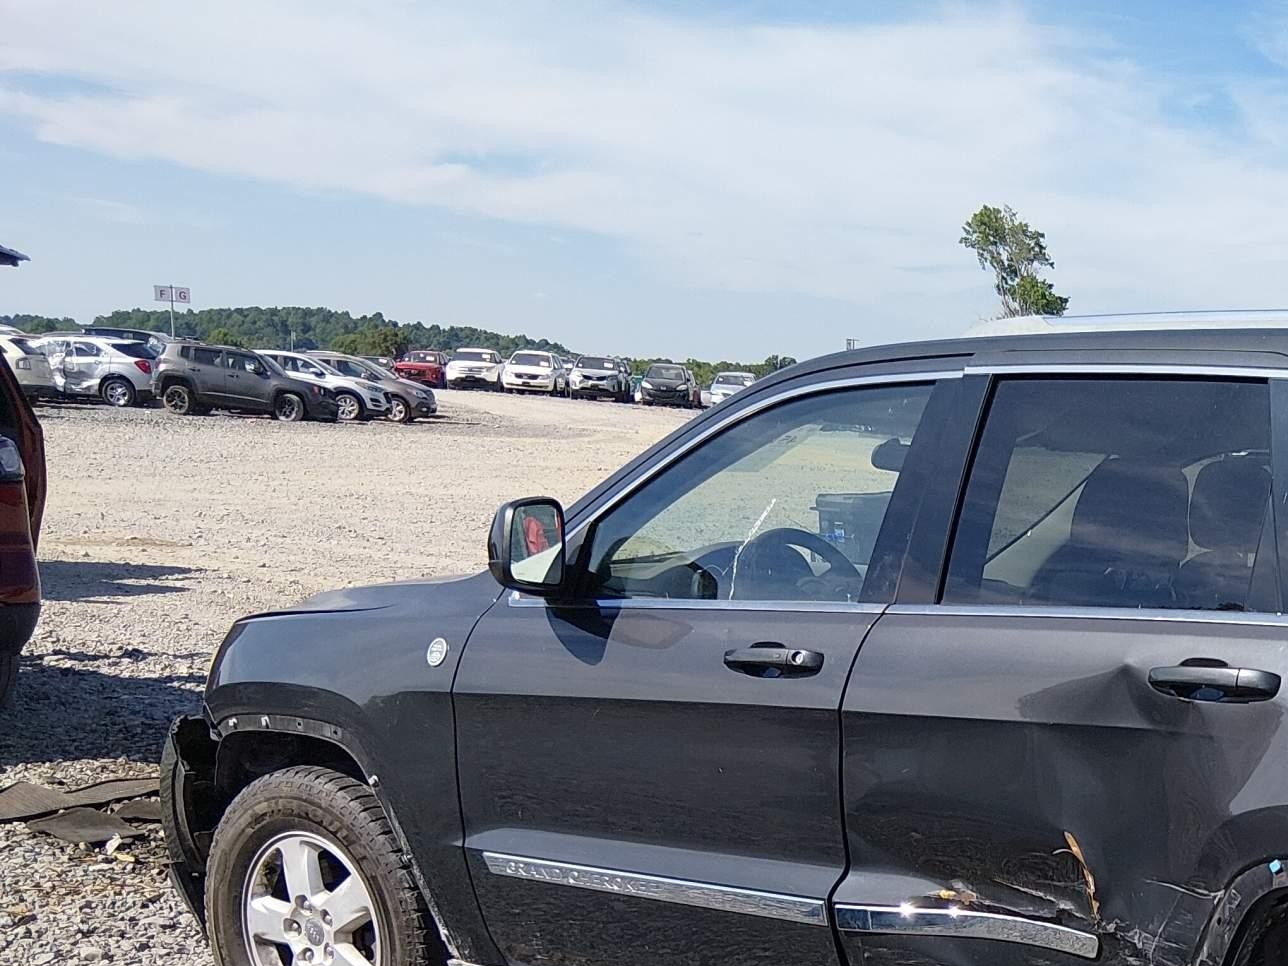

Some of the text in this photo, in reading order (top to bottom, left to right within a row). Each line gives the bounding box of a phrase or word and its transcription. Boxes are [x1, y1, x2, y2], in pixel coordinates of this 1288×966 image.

[159, 289, 187, 300] F G
[506, 861, 661, 896] GRAND CHEROKEE
